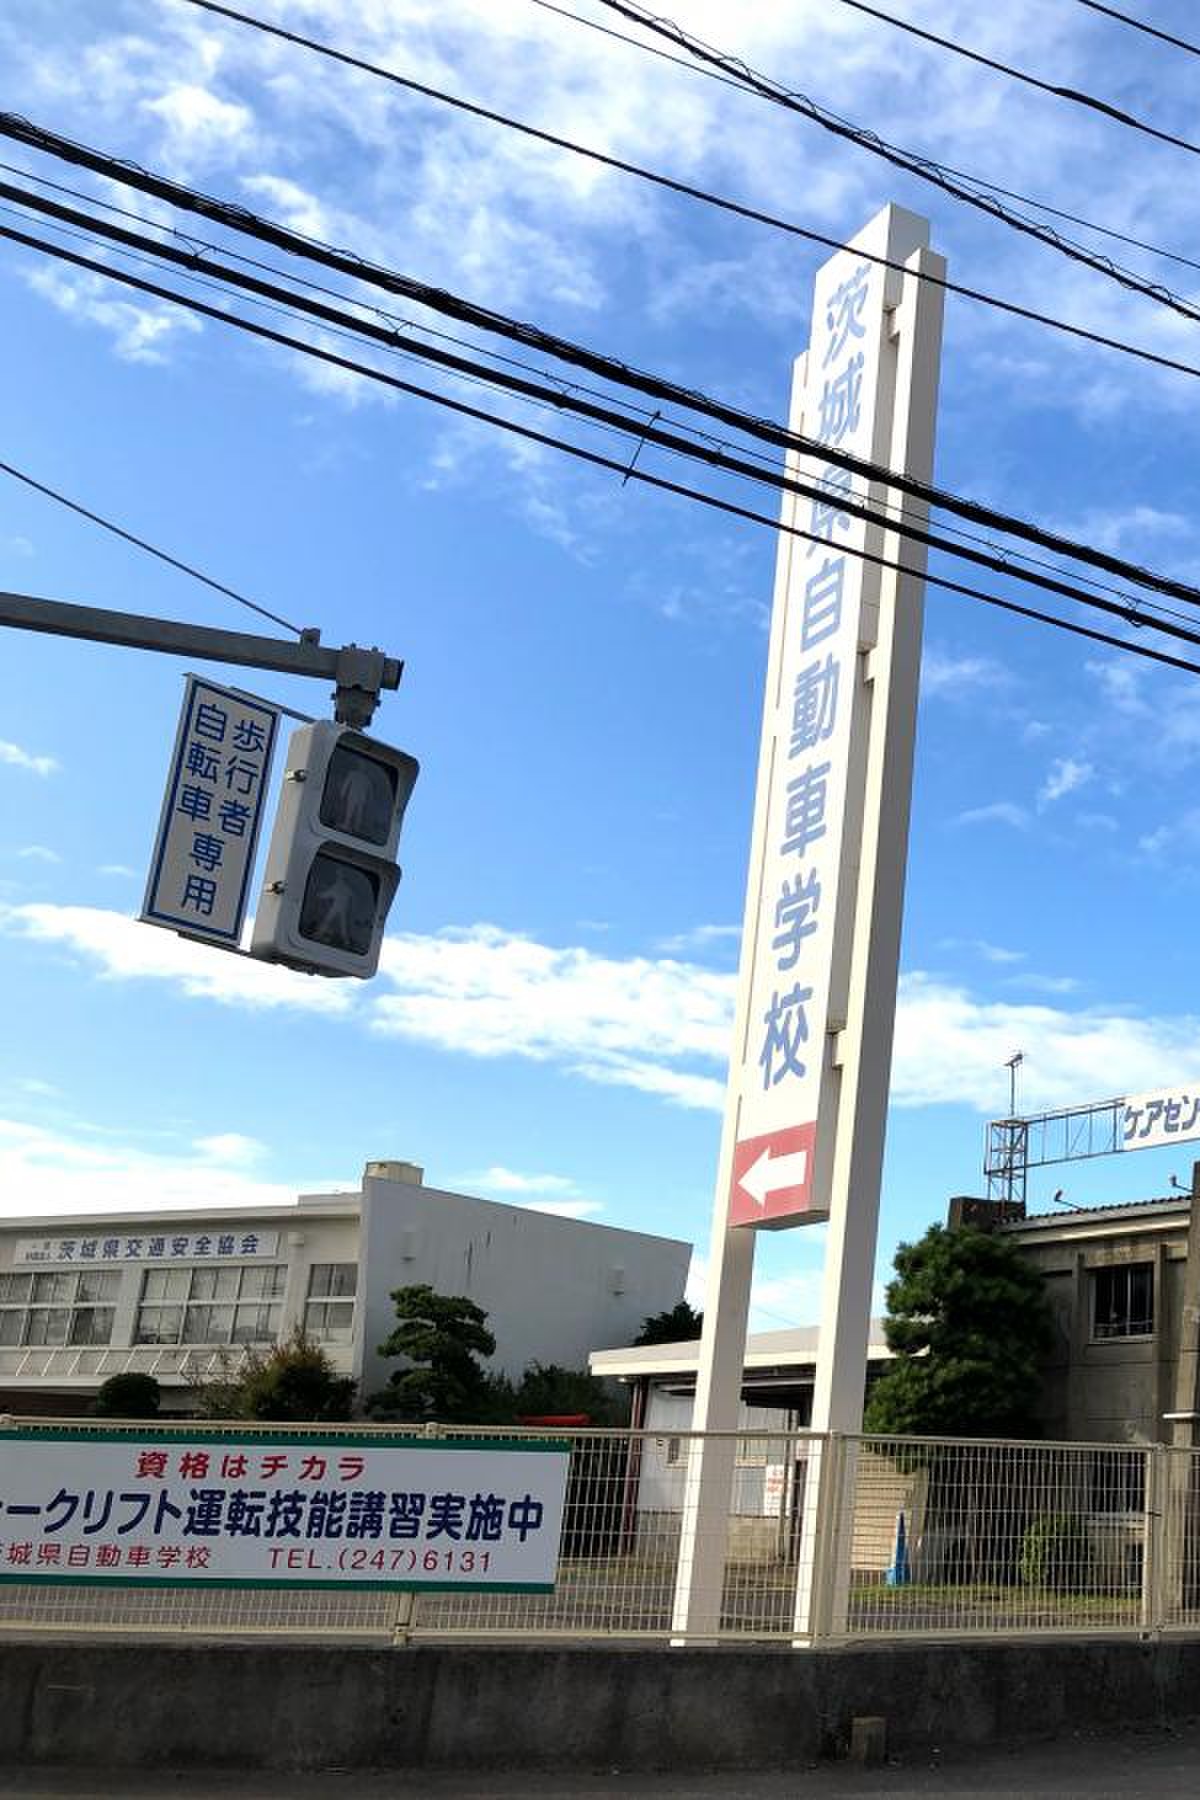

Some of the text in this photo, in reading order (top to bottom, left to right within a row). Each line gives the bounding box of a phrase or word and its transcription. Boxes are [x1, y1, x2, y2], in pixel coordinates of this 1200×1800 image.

[759, 263, 872, 1091] 茨城県自動車学校
[176, 703, 228, 822] 自転車
[217, 719, 265, 838] 歩行者
[181, 831, 225, 916] 専用
[58, 1235, 259, 1260] 茨城県交通安全協会
[136, 1451, 365, 1481] 資格はチカラ
[0, 1487, 544, 1542] ークリフト運転技能講習実施中
[0, 1542, 211, 1569] 城県自動車学校
